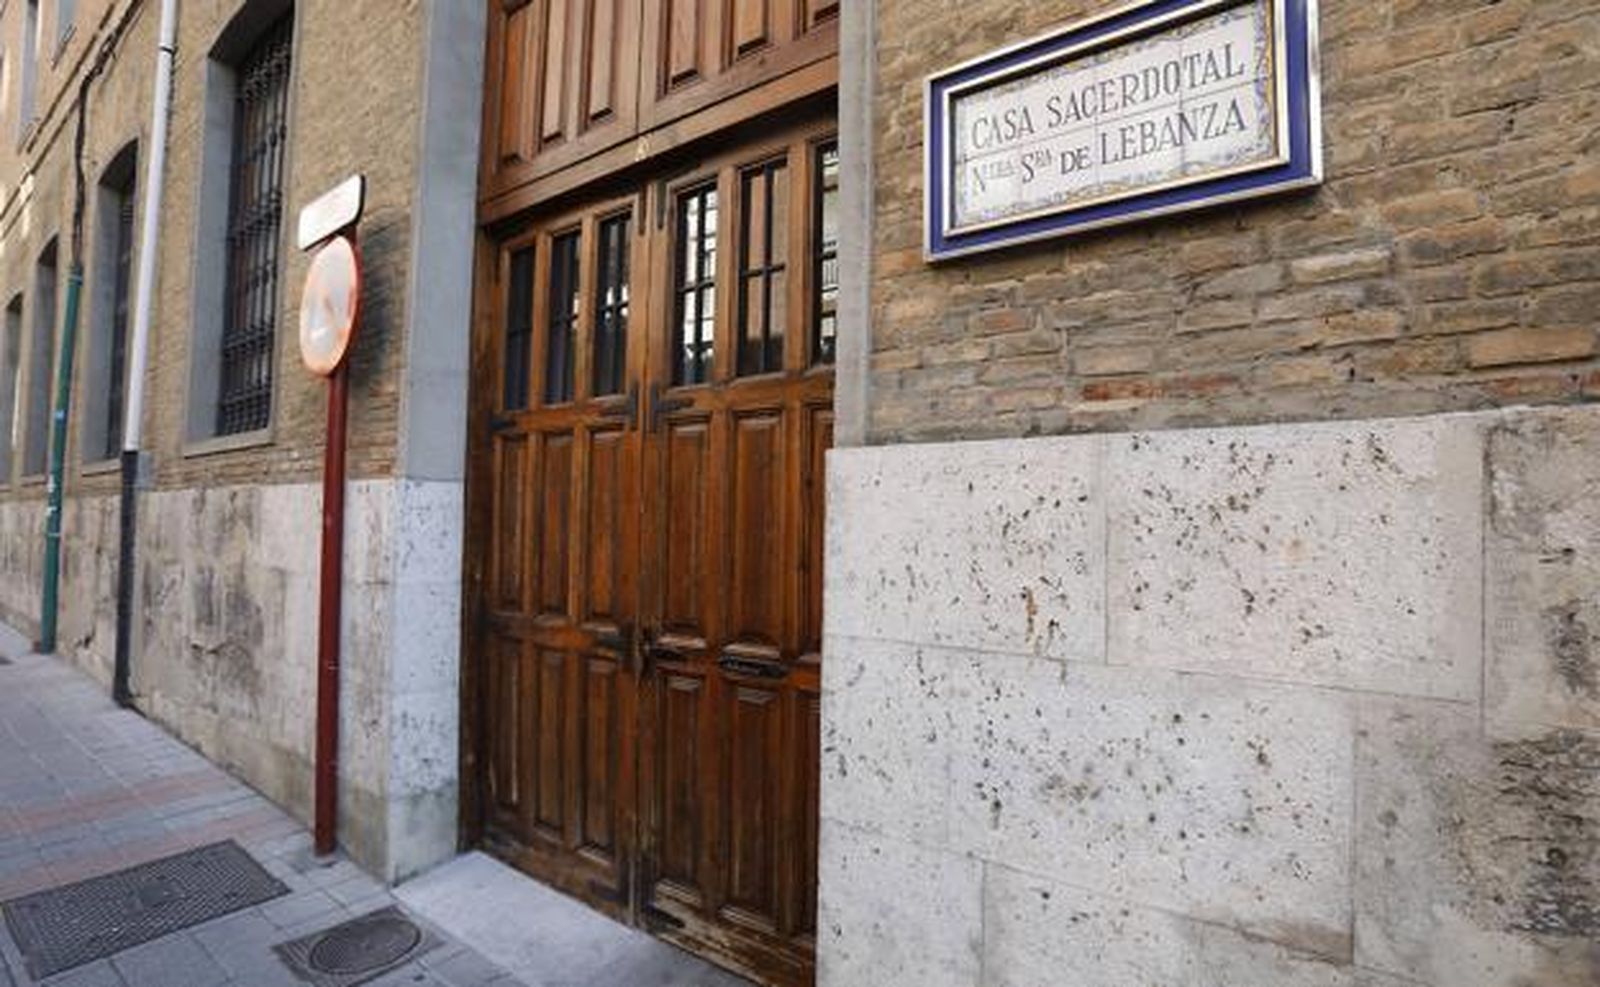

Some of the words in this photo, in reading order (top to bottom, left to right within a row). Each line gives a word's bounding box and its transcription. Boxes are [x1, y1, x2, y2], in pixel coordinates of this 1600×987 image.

[972, 106, 1034, 150] CASA
[1046, 43, 1244, 128] SACERDOTAL
[1060, 146, 1091, 175] DE
[1100, 98, 1246, 165] LEBANZA
